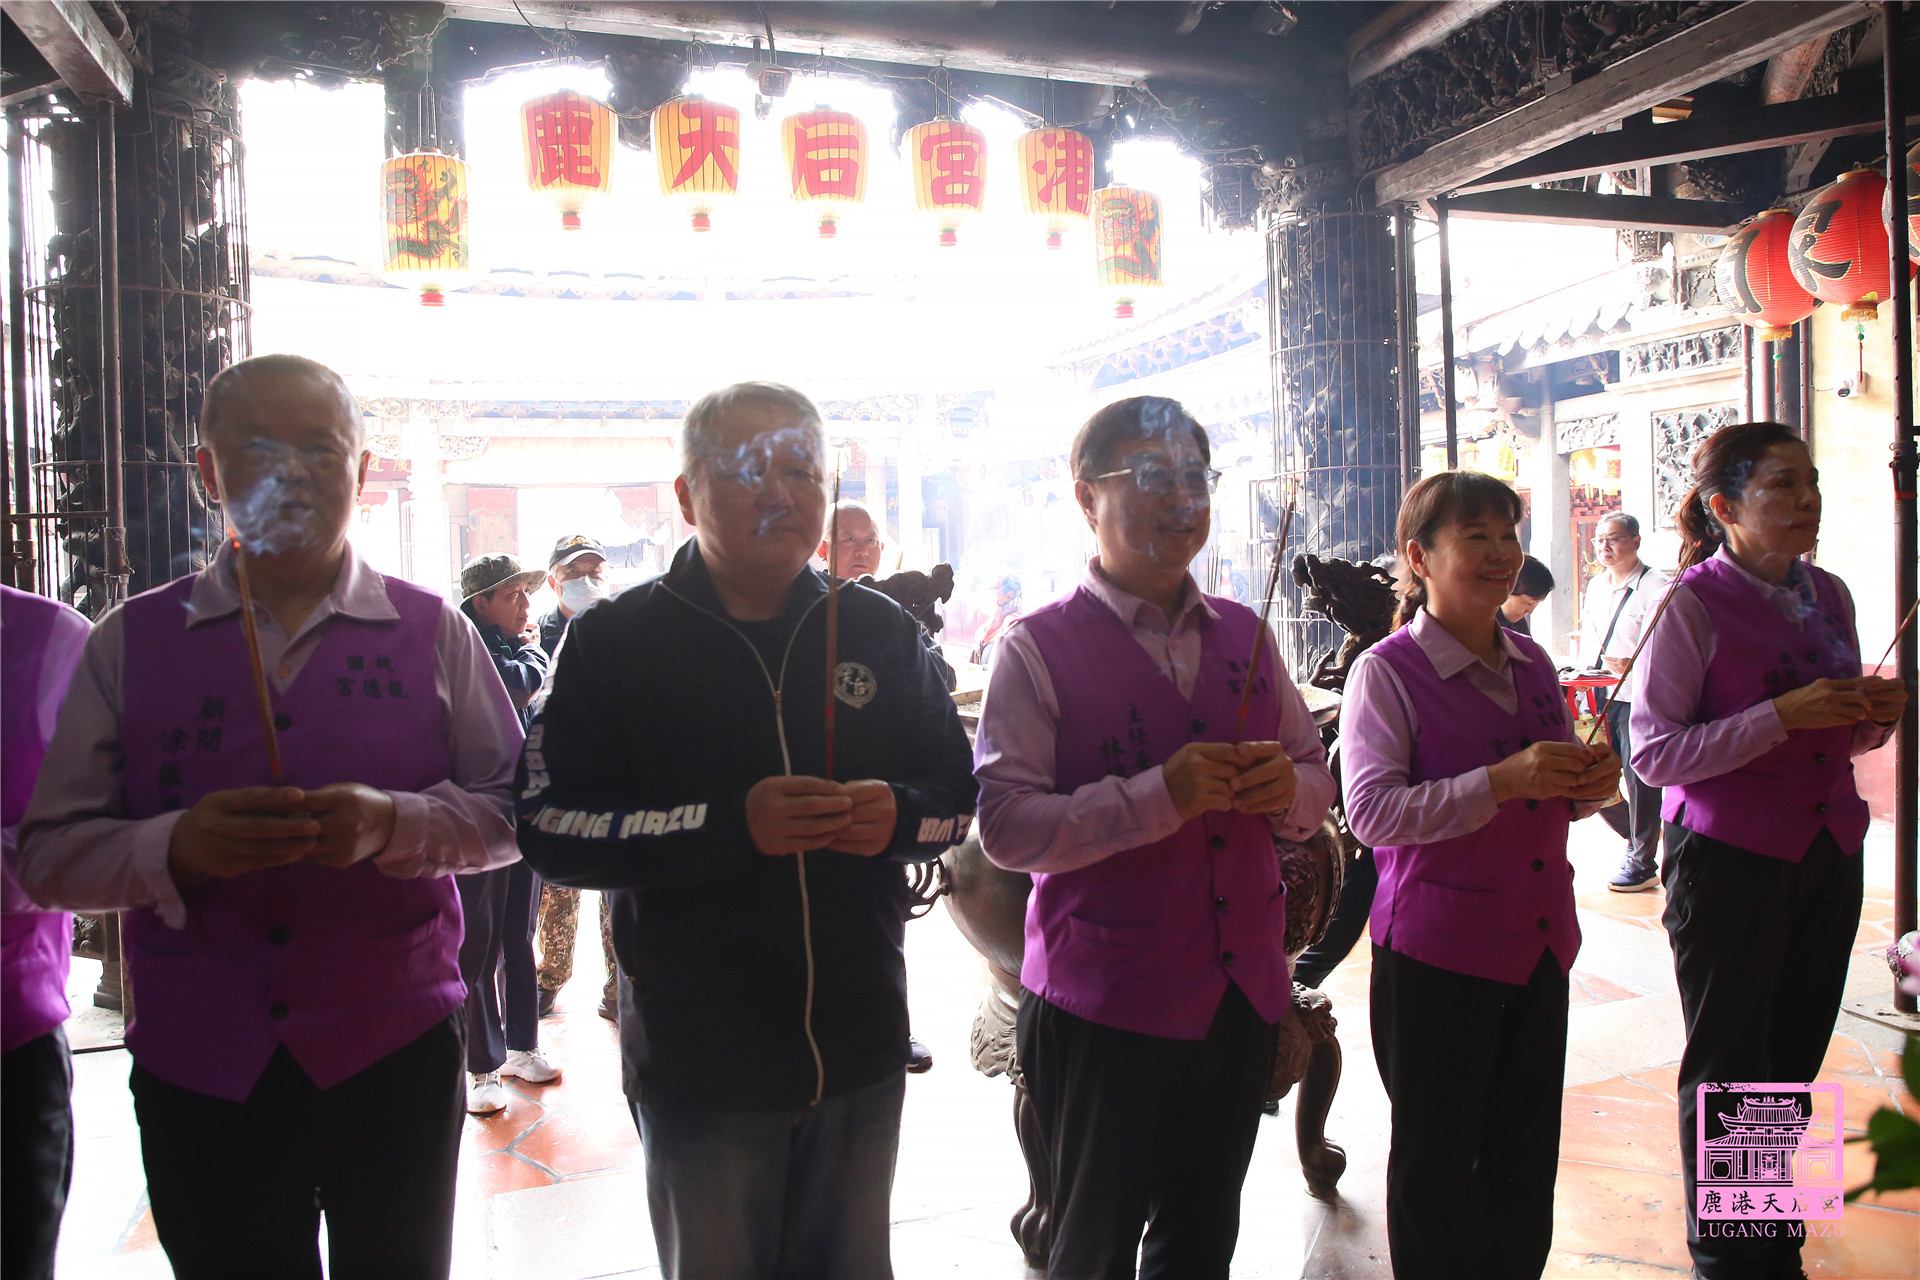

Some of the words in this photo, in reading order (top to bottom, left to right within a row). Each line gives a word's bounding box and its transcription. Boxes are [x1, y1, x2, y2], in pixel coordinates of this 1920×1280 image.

[525, 92, 602, 188] 鹿
[671, 102, 739, 190] 天
[791, 110, 859, 198] 后
[921, 120, 987, 208] 宮
[618, 803, 708, 840] MAZU
